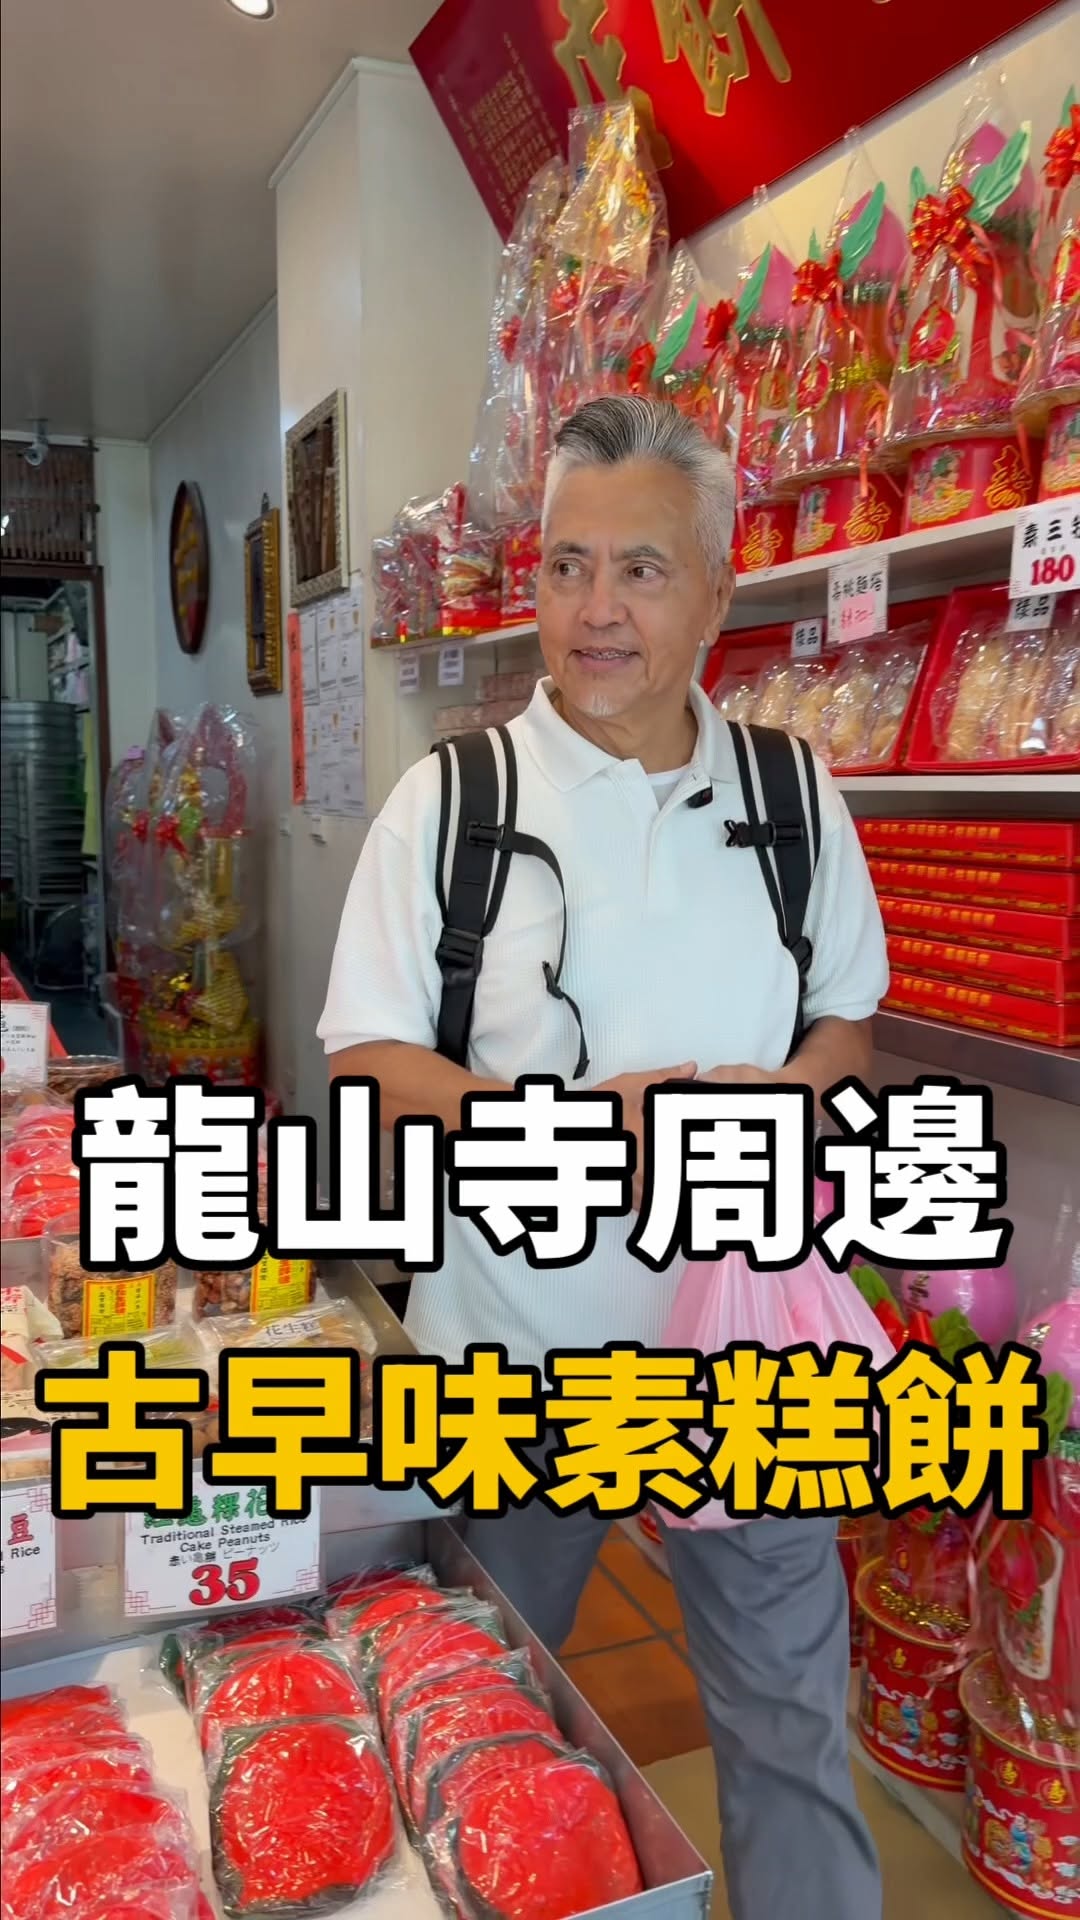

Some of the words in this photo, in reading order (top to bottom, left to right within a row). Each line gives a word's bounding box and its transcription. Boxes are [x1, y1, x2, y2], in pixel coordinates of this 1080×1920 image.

[1030, 553, 1076, 586] 180
[7, 1514, 34, 1545] 豆
[141, 1527, 214, 1545] Traditional
[221, 1519, 275, 1536] Steamed
[180, 1542, 212, 1553] Cake
[218, 1533, 271, 1549] Peanuts
[9, 1545, 41, 1559] Rice
[189, 1557, 260, 1606] 35
